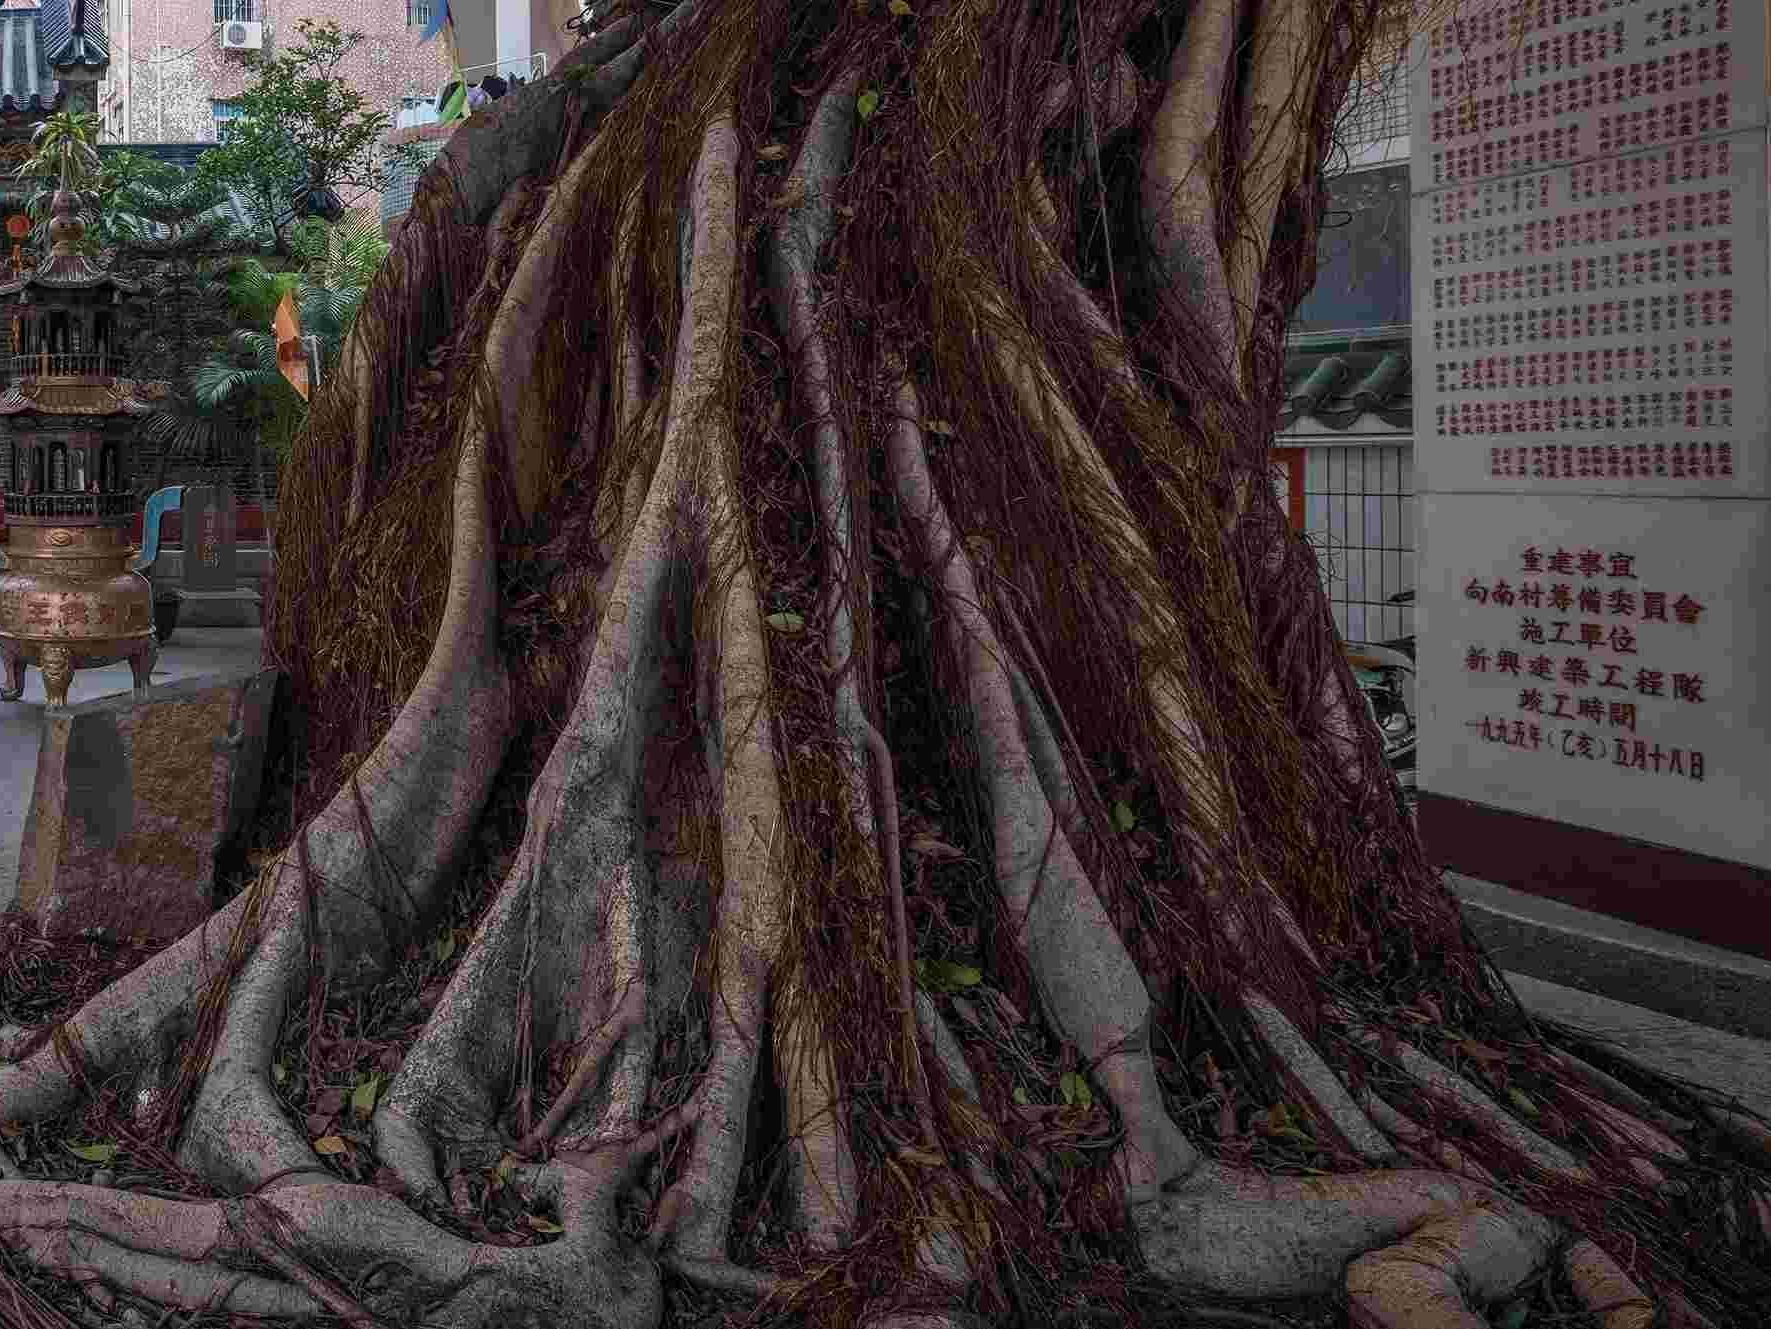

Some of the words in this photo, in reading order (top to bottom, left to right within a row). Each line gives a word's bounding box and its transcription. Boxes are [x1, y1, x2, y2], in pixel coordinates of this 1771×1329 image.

[1519, 547, 1637, 578] 重建事宜
[1519, 616, 1637, 655] 施工單位
[1464, 646, 1706, 704] 新興建築工程隊
[1519, 688, 1637, 732] 竣工時間
